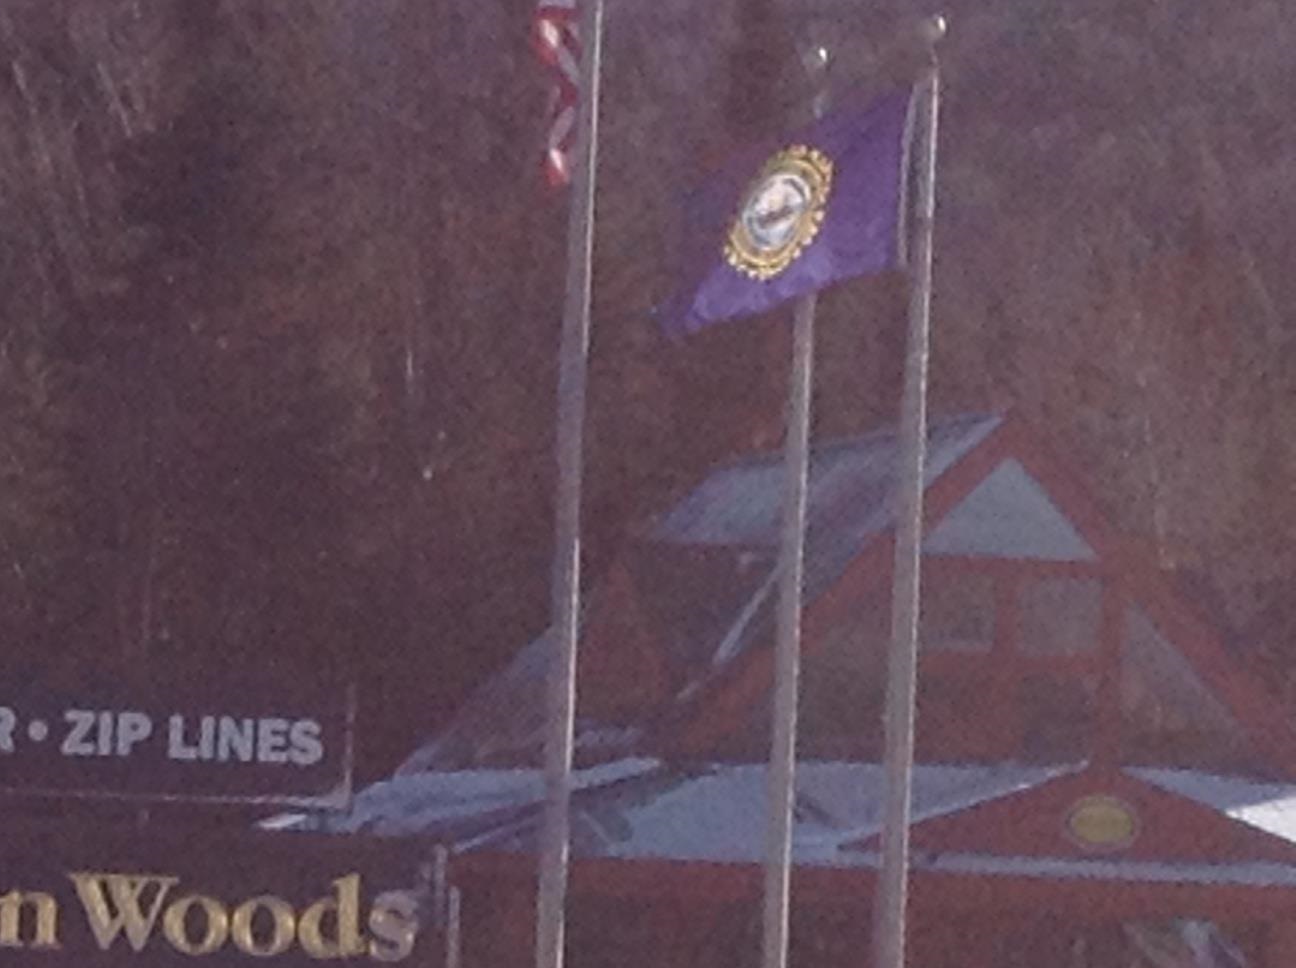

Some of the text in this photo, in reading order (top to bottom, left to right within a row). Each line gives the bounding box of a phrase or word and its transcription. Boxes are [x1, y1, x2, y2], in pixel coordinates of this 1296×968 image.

[61, 709, 153, 757] ZIP
[168, 713, 324, 766] LINES
[69, 872, 420, 963] Woods
